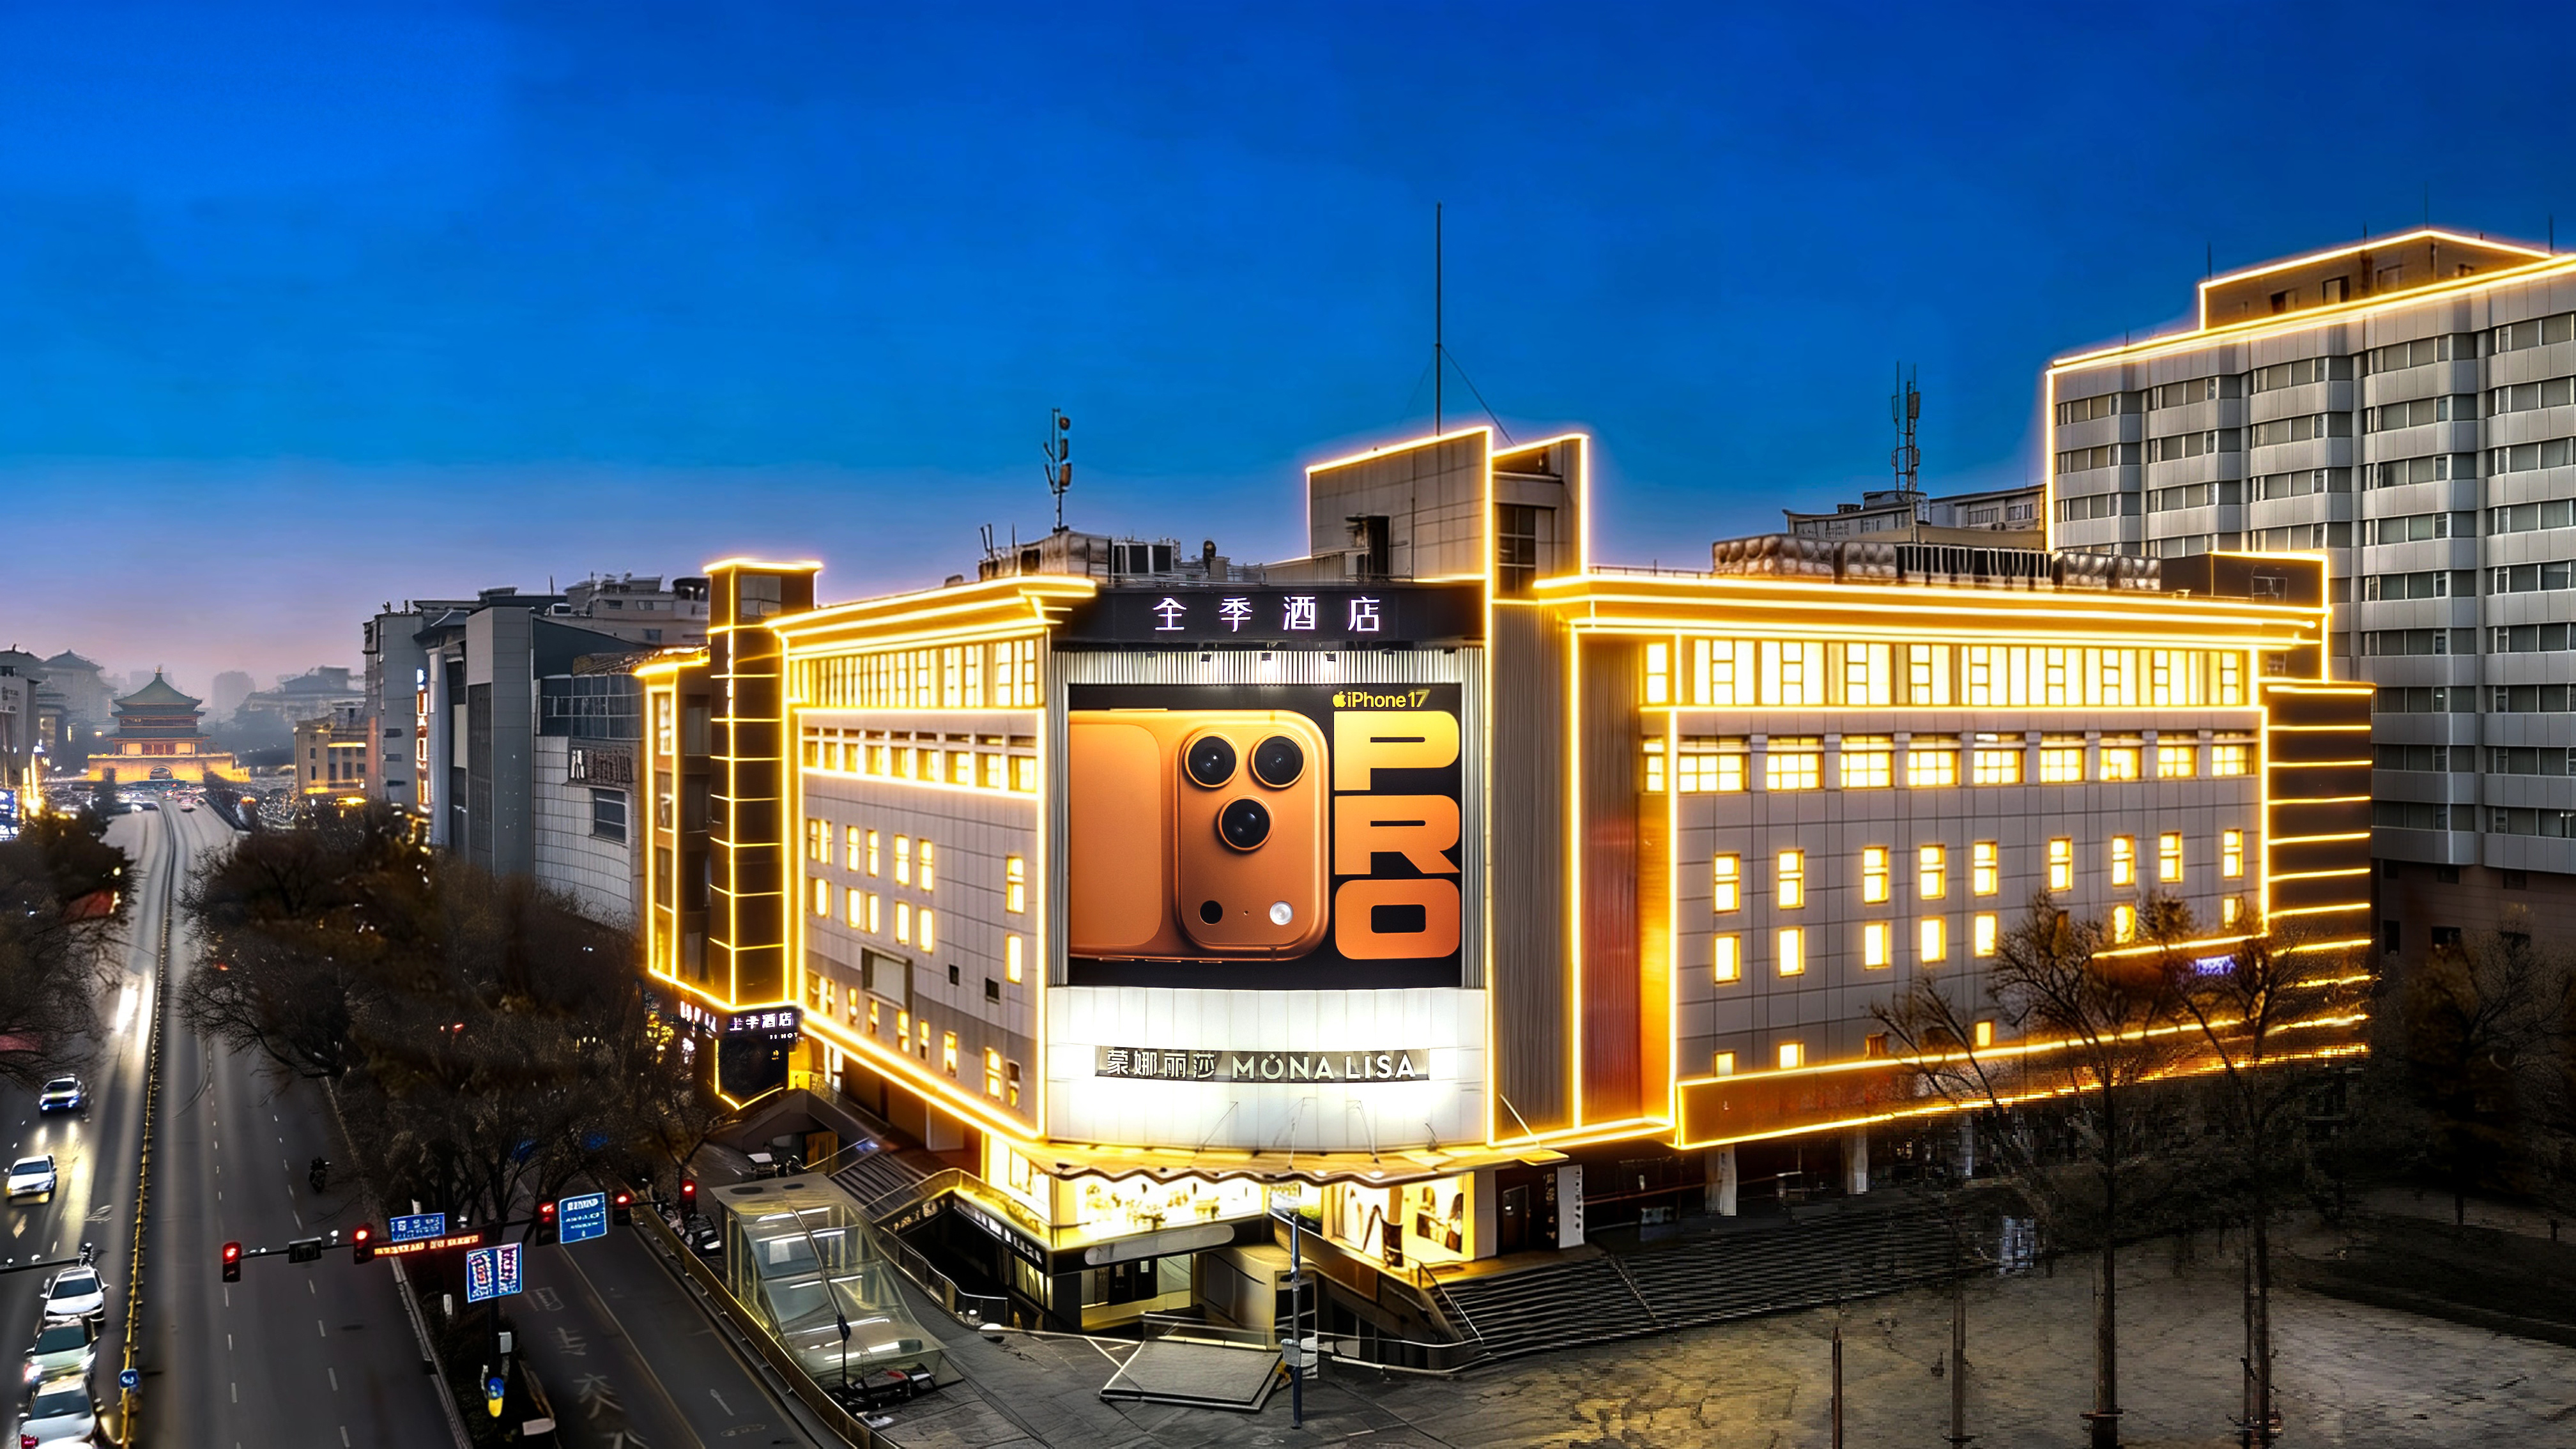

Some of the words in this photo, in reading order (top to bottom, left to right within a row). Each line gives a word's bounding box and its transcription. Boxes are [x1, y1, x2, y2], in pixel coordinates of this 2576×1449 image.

[1152, 596, 1380, 632] 全季酒店
[1347, 691, 1407, 708] iPhone
[1407, 689, 1431, 708] 17
[1333, 710, 1460, 960] PRO
[1107, 1049, 1215, 1078] 蒙娜丽莎
[1232, 1053, 1335, 1080] MONA
[1346, 1054, 1416, 1080] LISA
